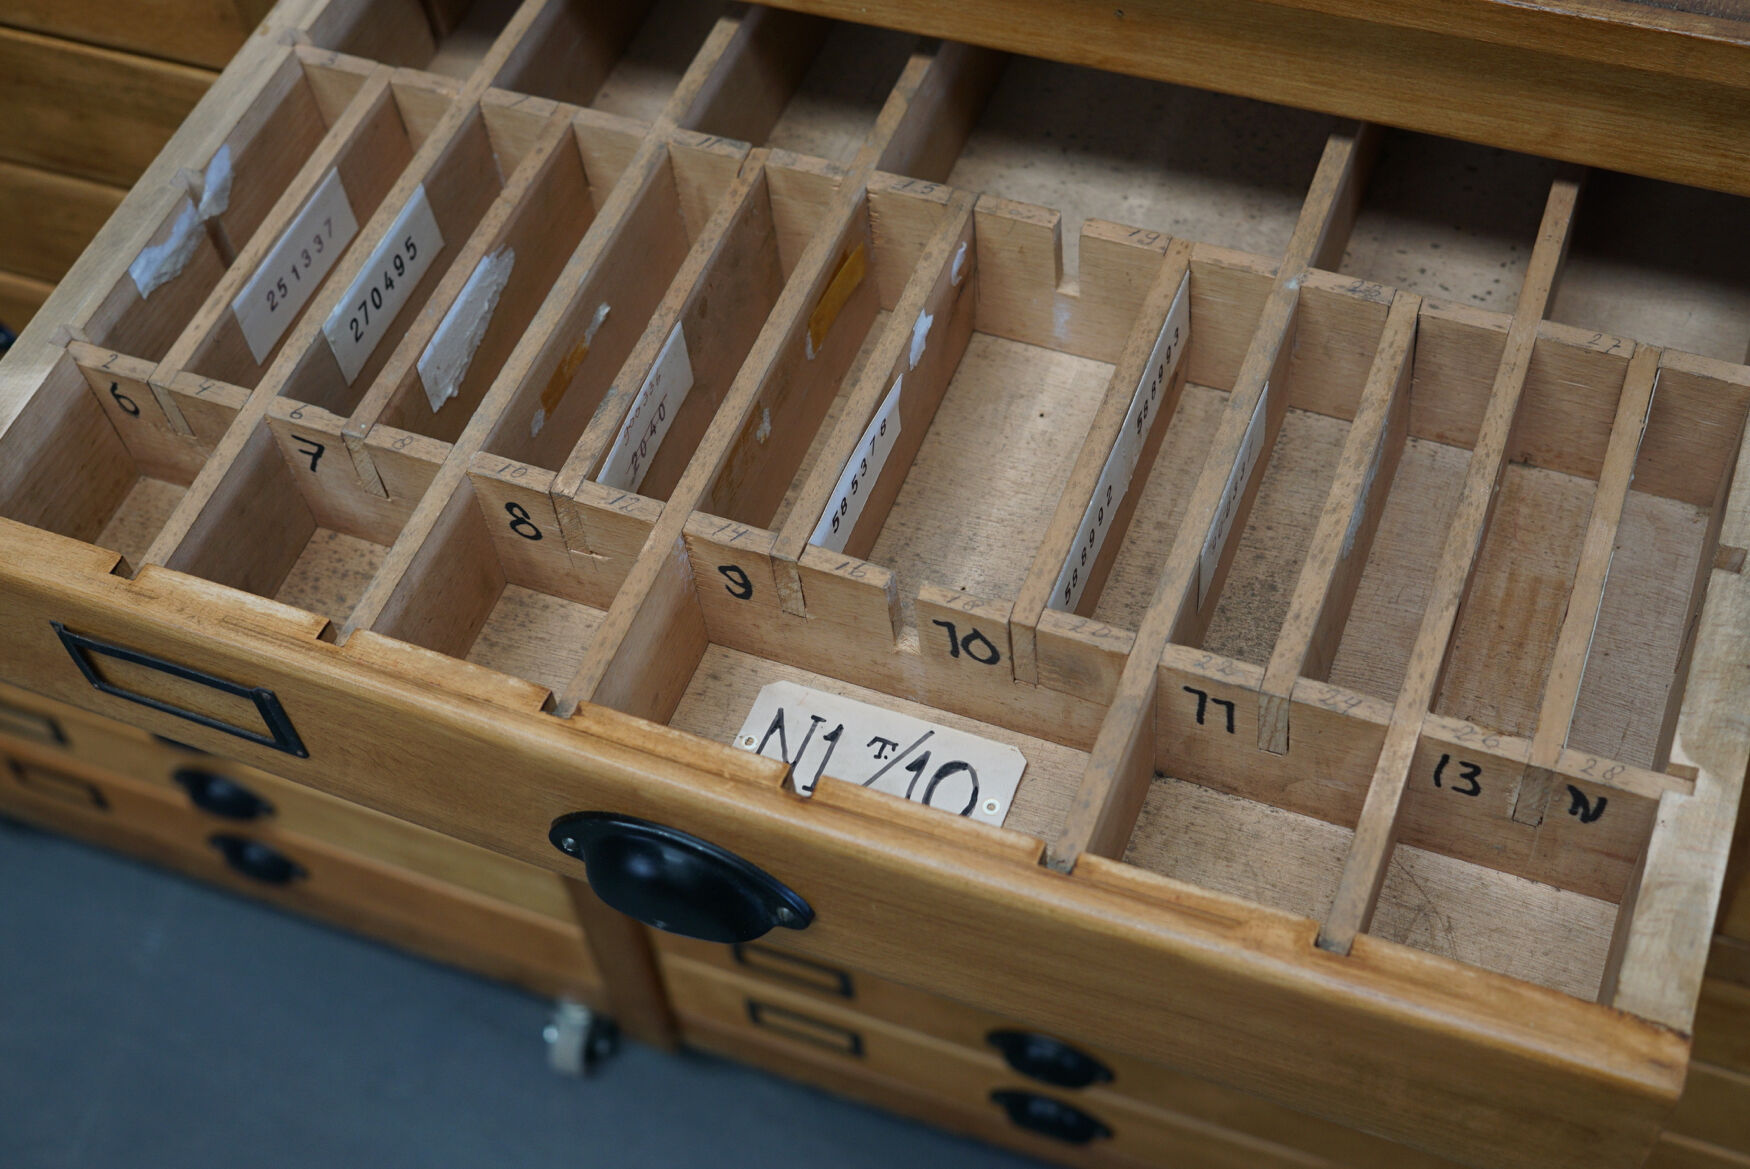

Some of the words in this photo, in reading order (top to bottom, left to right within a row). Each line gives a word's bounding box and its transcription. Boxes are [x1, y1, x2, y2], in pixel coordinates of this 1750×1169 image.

[266, 217, 333, 312] 251337
[350, 236, 418, 343] 270495
[102, 353, 119, 369] 2
[110, 380, 141, 418] 6
[289, 404, 309, 420] 6
[291, 434, 325, 473] 7
[392, 435, 414, 450] 8
[496, 463, 529, 479] 10
[831, 417, 887, 534] 585378
[504, 501, 544, 541] 8
[711, 523, 750, 543] 14
[1064, 484, 1113, 606] 588992
[718, 564, 753, 600] 9
[834, 561, 867, 579] 16
[1452, 725, 1500, 750] 26
[1433, 753, 1483, 797] 13
[1580, 758, 1626, 781] 28
